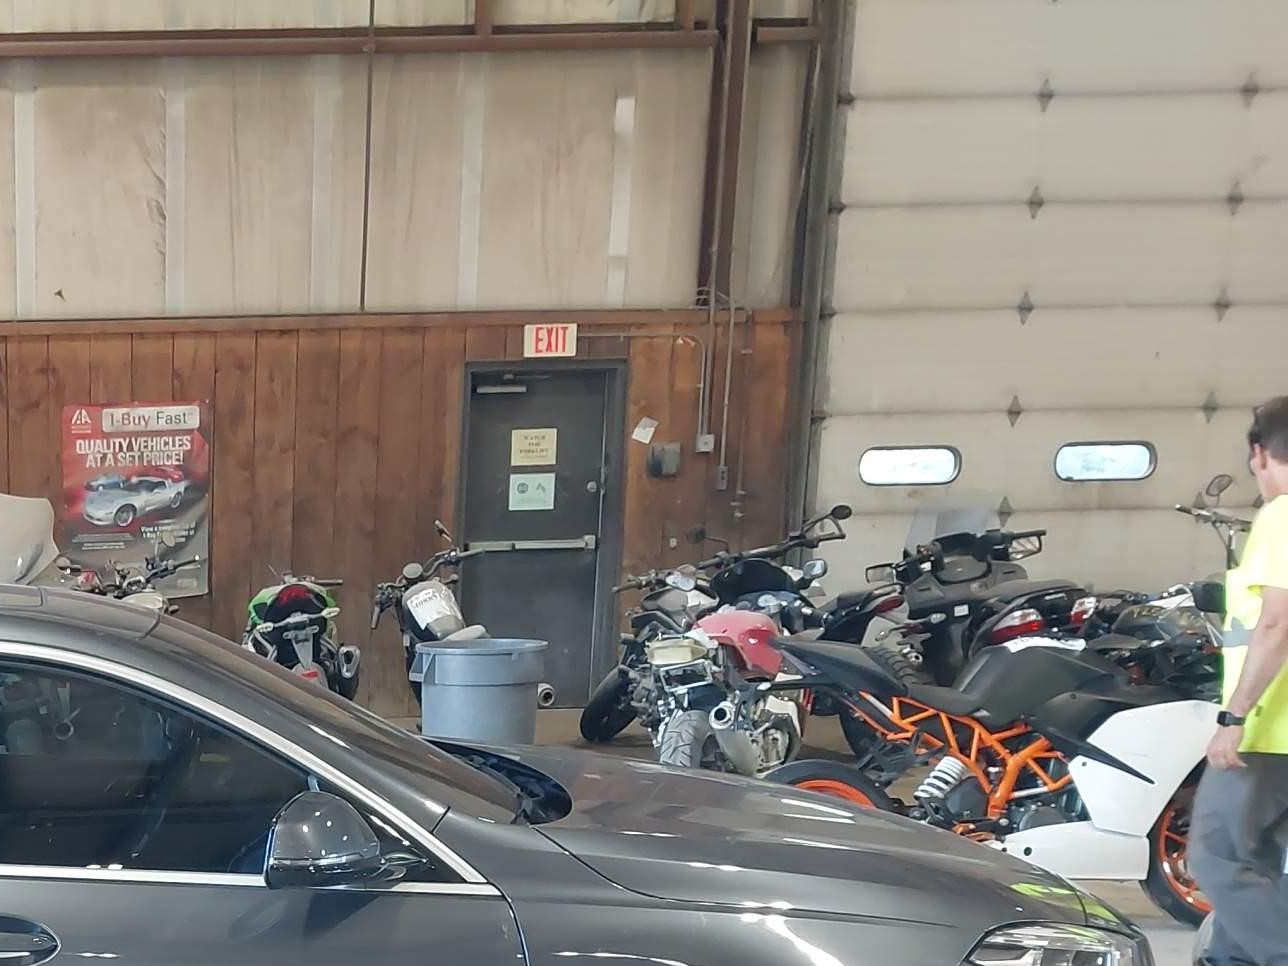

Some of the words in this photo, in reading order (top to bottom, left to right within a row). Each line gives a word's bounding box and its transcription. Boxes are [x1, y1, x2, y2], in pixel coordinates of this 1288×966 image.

[535, 326, 568, 353] EXIT
[110, 411, 151, 428] I-Buy
[156, 410, 188, 425] Fast
[76, 437, 130, 455] QUALITY
[131, 435, 191, 453] VEHICLES
[86, 453, 104, 468] AT
[105, 453, 115, 468] A
[117, 452, 141, 468] SET
[143, 450, 184, 466] PRICE!
